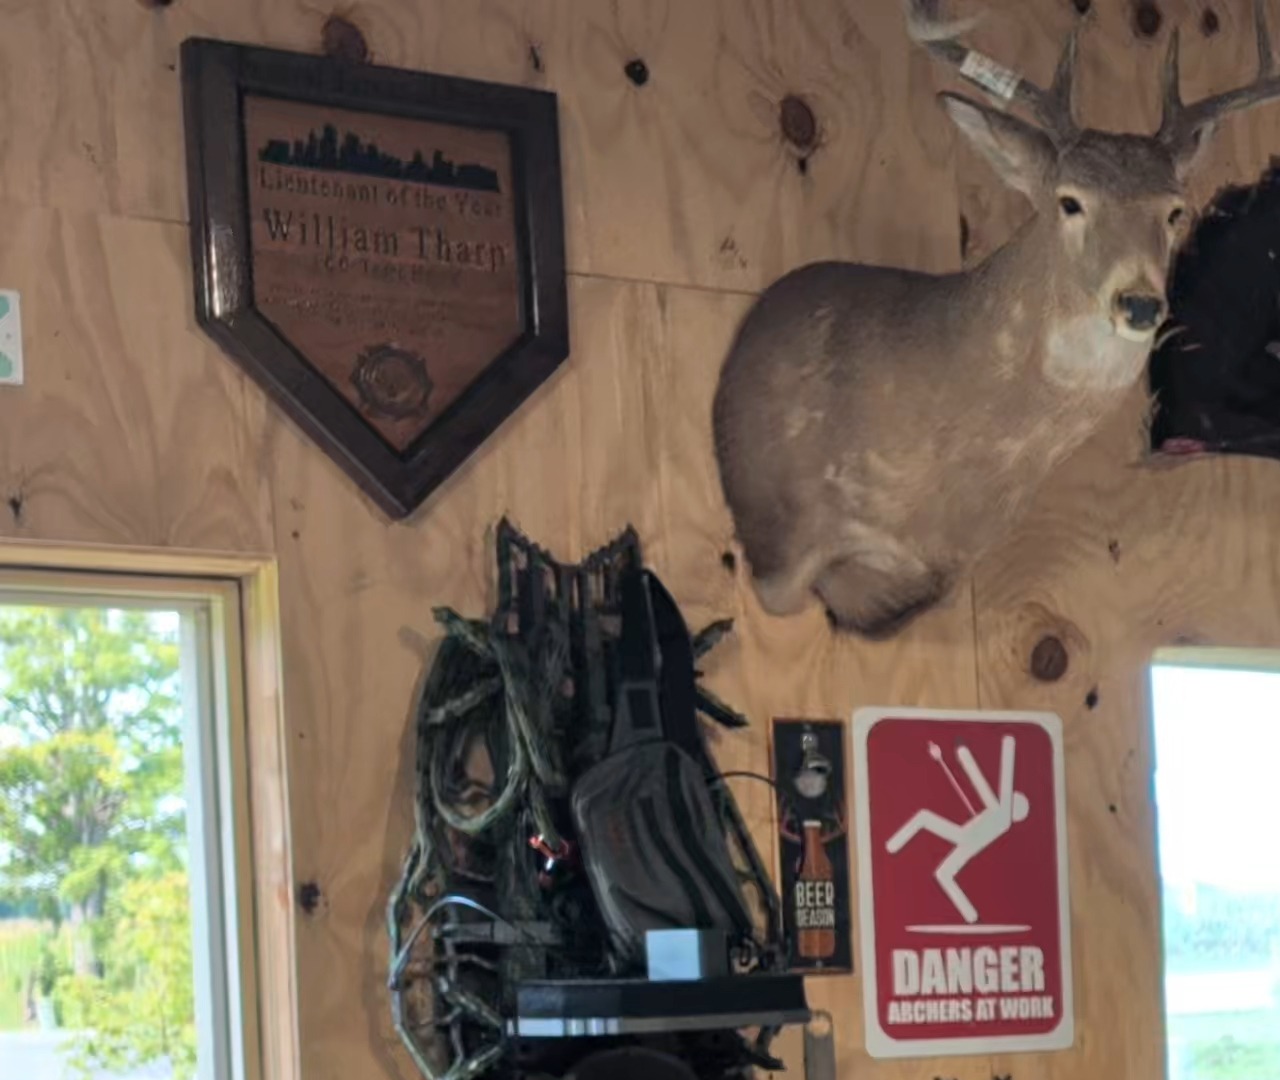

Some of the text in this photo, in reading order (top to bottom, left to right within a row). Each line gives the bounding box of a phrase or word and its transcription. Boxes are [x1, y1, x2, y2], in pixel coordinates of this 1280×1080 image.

[260, 167, 378, 201] Lieutenant
[386, 187, 408, 204] of
[414, 188, 447, 210] the
[263, 207, 399, 256] William
[408, 225, 507, 273] Tharp
[796, 881, 835, 908] BEER
[892, 945, 1046, 996] DANGER
[888, 995, 1055, 1025] ARCHERS AT WORK
